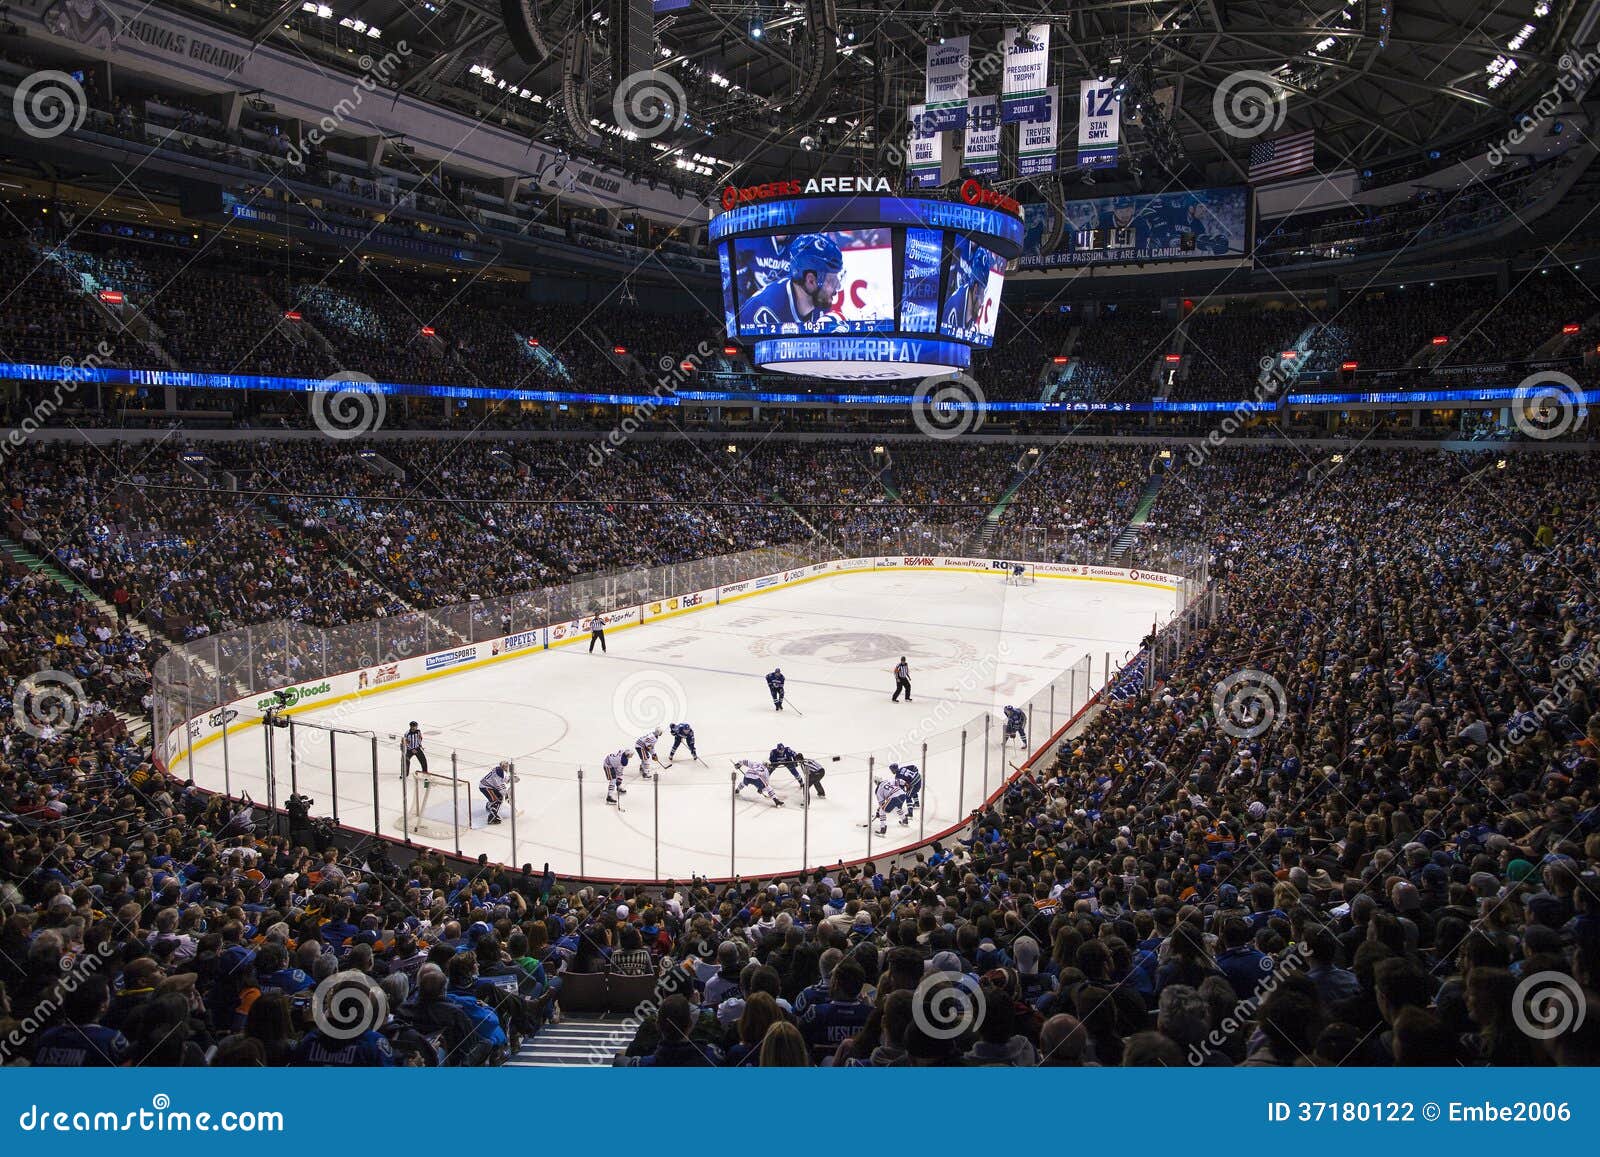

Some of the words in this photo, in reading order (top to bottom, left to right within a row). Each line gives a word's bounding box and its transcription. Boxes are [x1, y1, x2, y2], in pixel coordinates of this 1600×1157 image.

[1013, 73, 1036, 82] TROPHY
[1086, 88, 1114, 118] 12
[1090, 121, 1108, 131] STAN
[1026, 127, 1051, 137] TREVOR
[1088, 129, 1109, 139] SMYL
[971, 135, 996, 144] MARKUS
[1025, 136, 1051, 146] LINDEN
[915, 143, 933, 152] PAVEL
[915, 151, 933, 160] BURE
[738, 180, 801, 202] ROGERS
[804, 177, 892, 193] ARENA
[236, 206, 258, 219] TEAM
[1057, 254, 1071, 263] ARE
[1107, 252, 1119, 261] WE
[1121, 251, 1135, 260] ARE
[1137, 250, 1150, 259] ALL
[770, 324, 777, 334] 2
[803, 321, 826, 331] 10:31
[855, 321, 861, 331] 2
[1066, 403, 1072, 411] 2
[1125, 403, 1131, 411] 2
[904, 557, 935, 567] RE/MAX
[1091, 568, 1125, 577] Scotiabank
[1141, 574, 1168, 584] ROGERS
[722, 583, 750, 595] SPORTSNET
[683, 594, 704, 608] FedEx
[624, 611, 635, 619] Hut
[505, 631, 537, 649] POPEYE'S
[455, 647, 476, 660] SPORTS
[299, 682, 331, 699] foods
